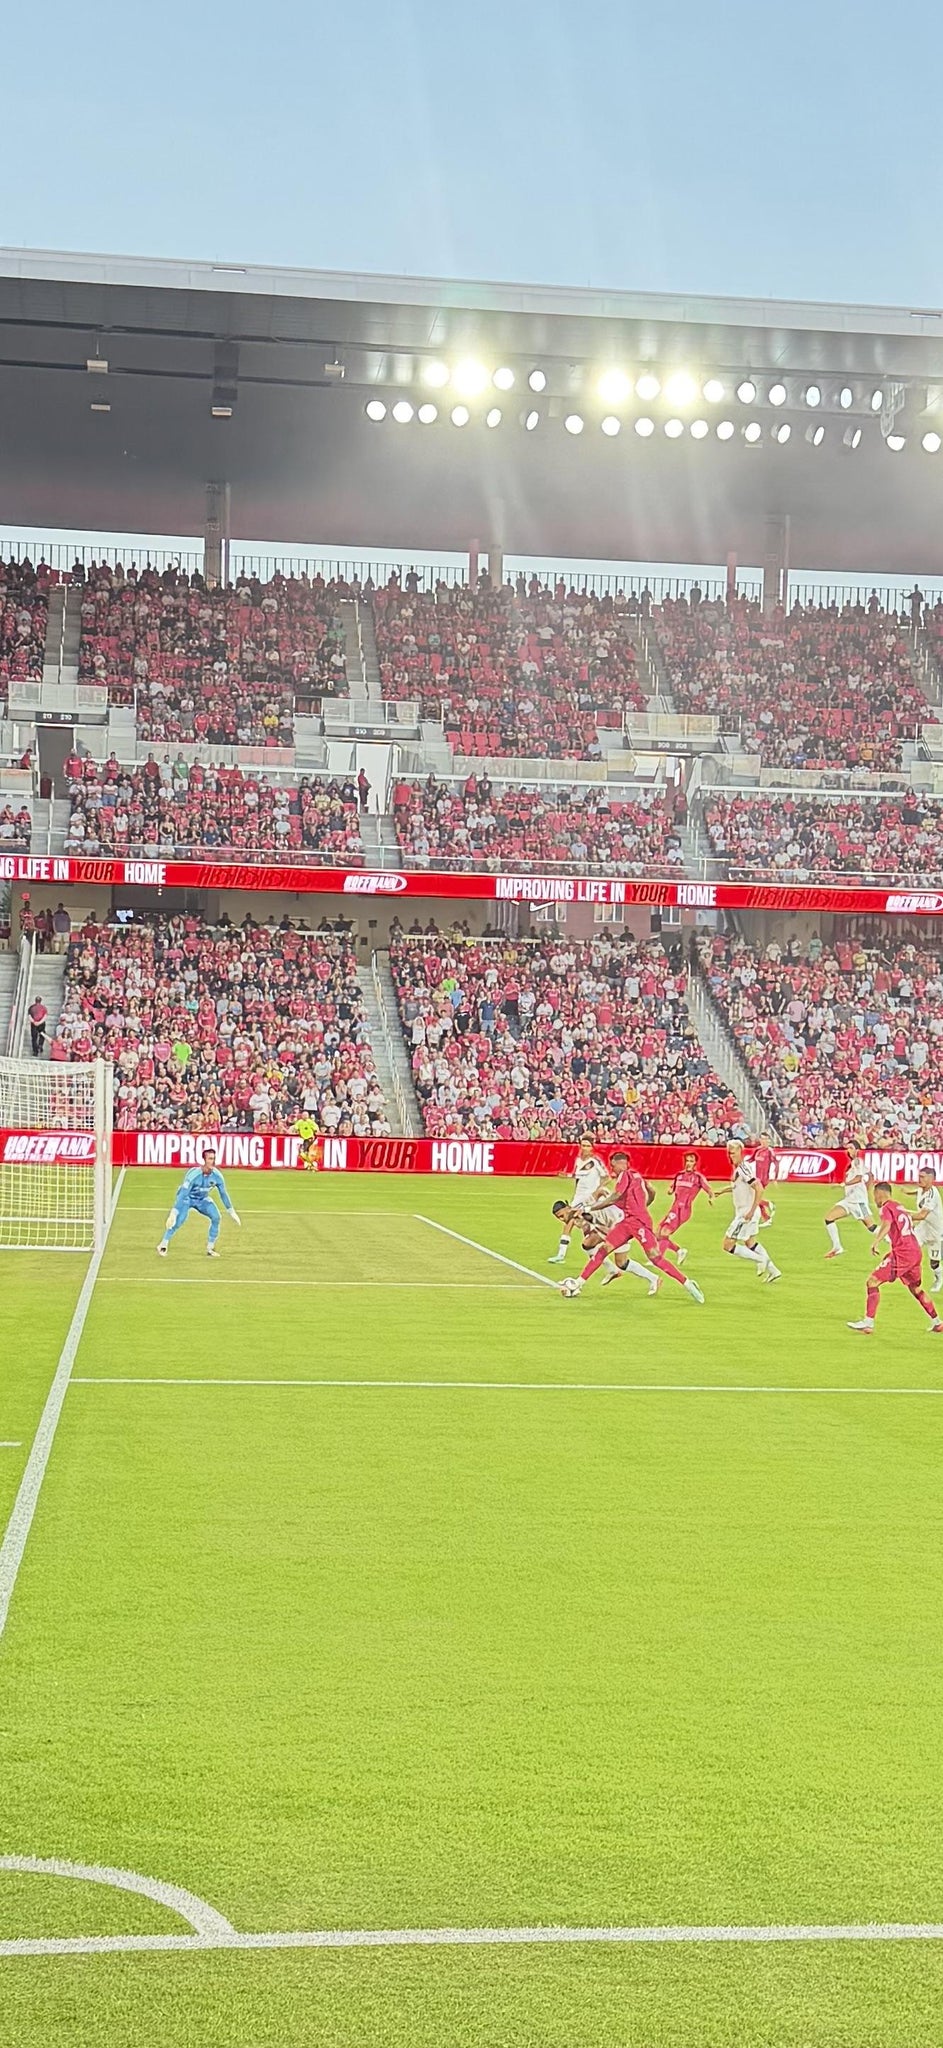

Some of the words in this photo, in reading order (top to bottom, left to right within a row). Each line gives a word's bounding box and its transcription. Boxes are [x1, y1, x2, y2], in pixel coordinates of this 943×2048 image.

[18, 858, 50, 879] LIFE
[53, 859, 70, 880] IN
[75, 861, 115, 881] YOUR
[124, 863, 167, 884] HOME
[495, 878, 574, 900] IMPROVING
[577, 881, 606, 902] LIFE
[610, 883, 625, 903] IN
[631, 884, 670, 904] YOUR
[677, 885, 717, 906] HOME
[4, 1136, 93, 1156] HOFFMANN
[137, 1134, 265, 1167] IMPROVING
[270, 1136, 318, 1168] LIF
[324, 1138, 347, 1168] IN
[358, 1140, 418, 1169] YOUR
[432, 1142, 494, 1173] HOME
[897, 1213, 914, 1236] 2
